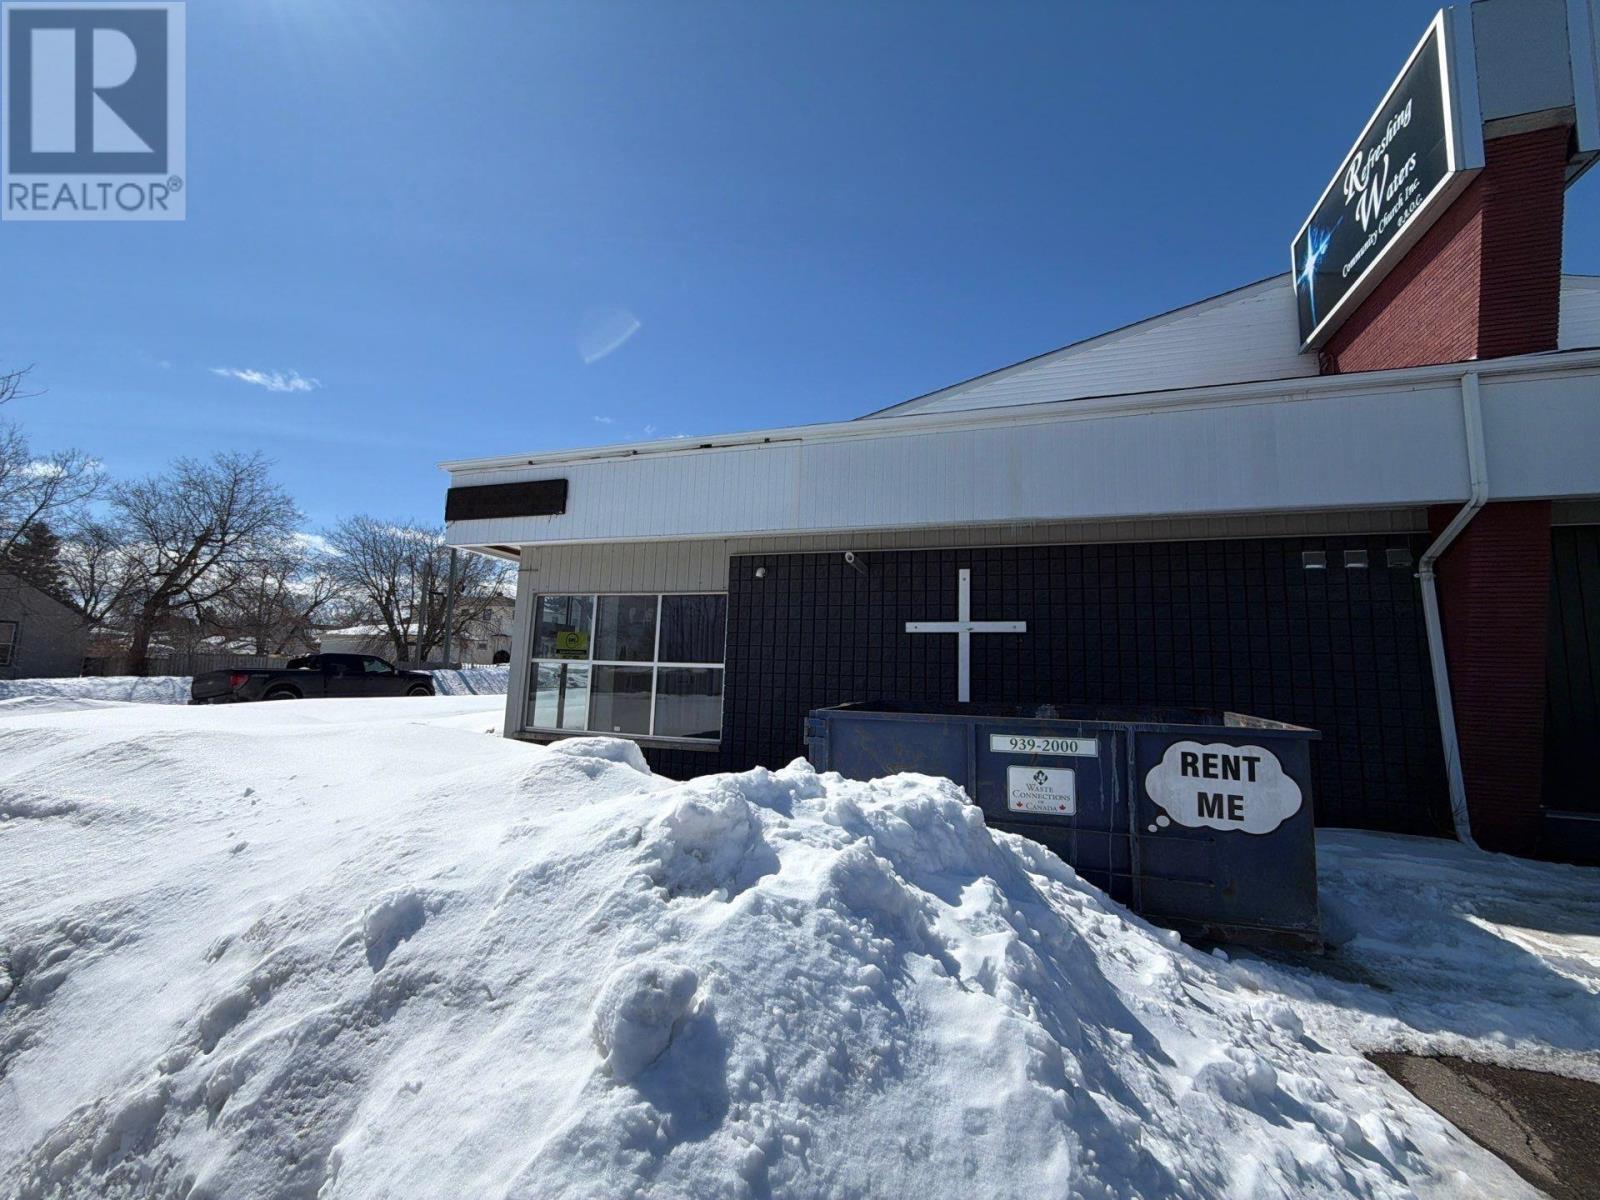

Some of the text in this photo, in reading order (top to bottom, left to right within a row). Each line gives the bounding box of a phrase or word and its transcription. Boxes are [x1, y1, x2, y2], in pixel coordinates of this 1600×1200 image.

[1343, 98, 1413, 206] Refreshing
[1355, 155, 1416, 232] Waters
[1342, 230, 1377, 277] Community
[1378, 192, 1404, 234] Church
[1009, 737, 1079, 753] 939-2000
[1180, 751, 1261, 782] RENT
[1012, 790, 1071, 801] CONNECTIONS
[1197, 791, 1245, 821] ME
